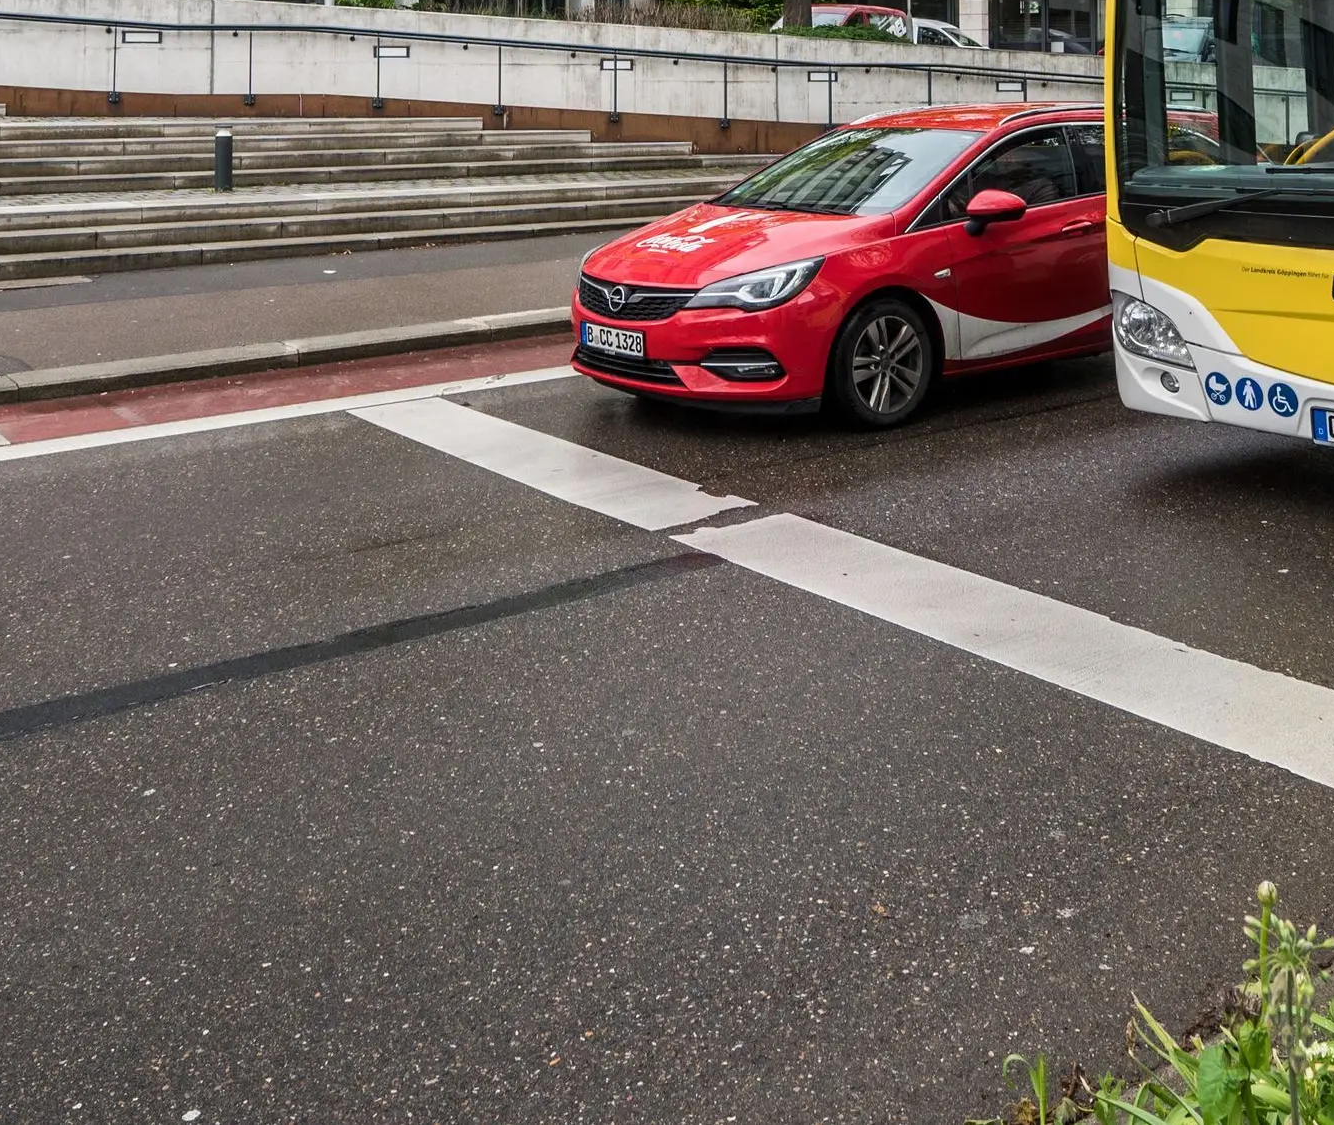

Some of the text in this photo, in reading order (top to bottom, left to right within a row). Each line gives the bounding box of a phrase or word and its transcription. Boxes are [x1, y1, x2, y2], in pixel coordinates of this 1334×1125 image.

[1250, 266, 1276, 274] Landkreis
[1276, 269, 1307, 278] Göppingen
[587, 326, 642, 353] B CC 1328
